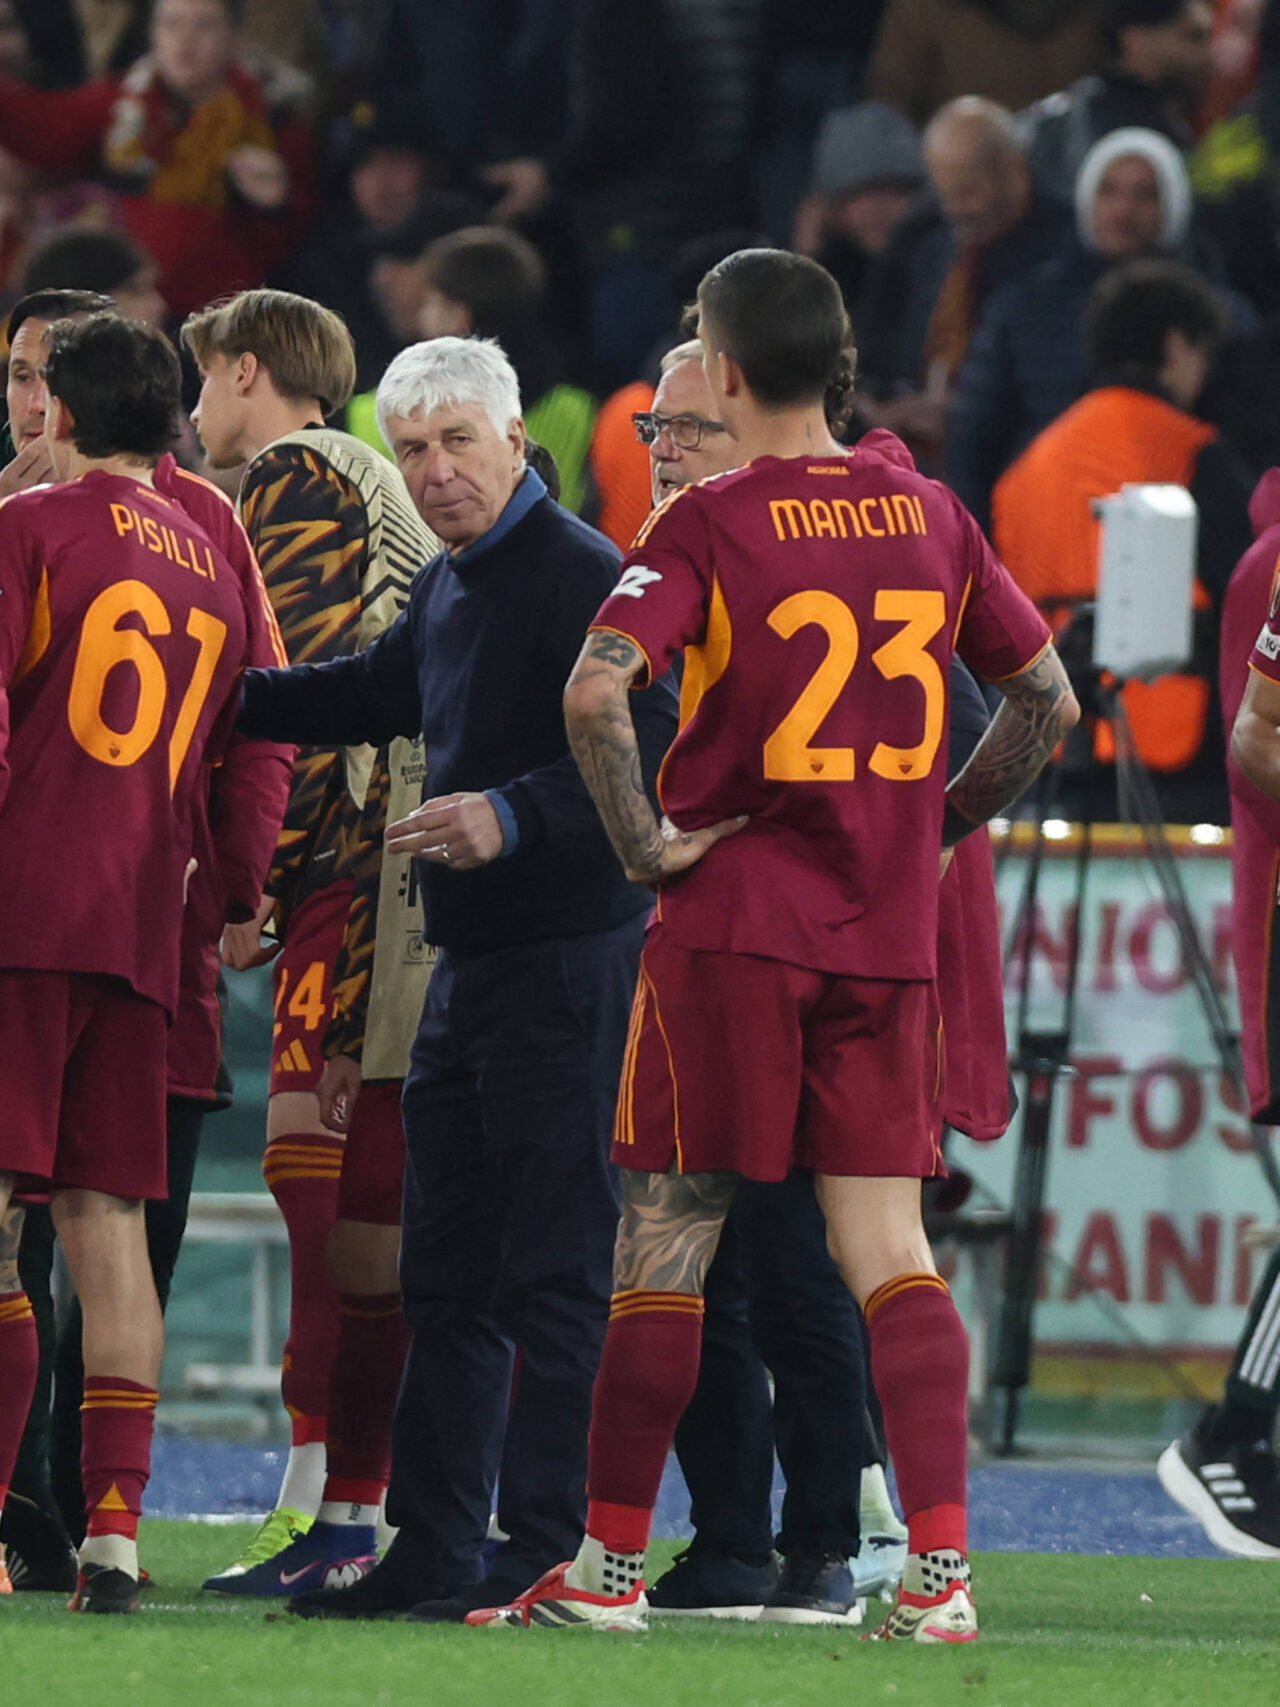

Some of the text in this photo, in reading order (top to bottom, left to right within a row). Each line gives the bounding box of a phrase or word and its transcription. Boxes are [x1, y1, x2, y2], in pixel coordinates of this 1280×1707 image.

[110, 502, 217, 583] PISILLI
[768, 494, 928, 542] MANCINI
[67, 578, 228, 800] 61
[763, 589, 947, 782] 23
[1040, 1206, 1253, 1308] ANI
